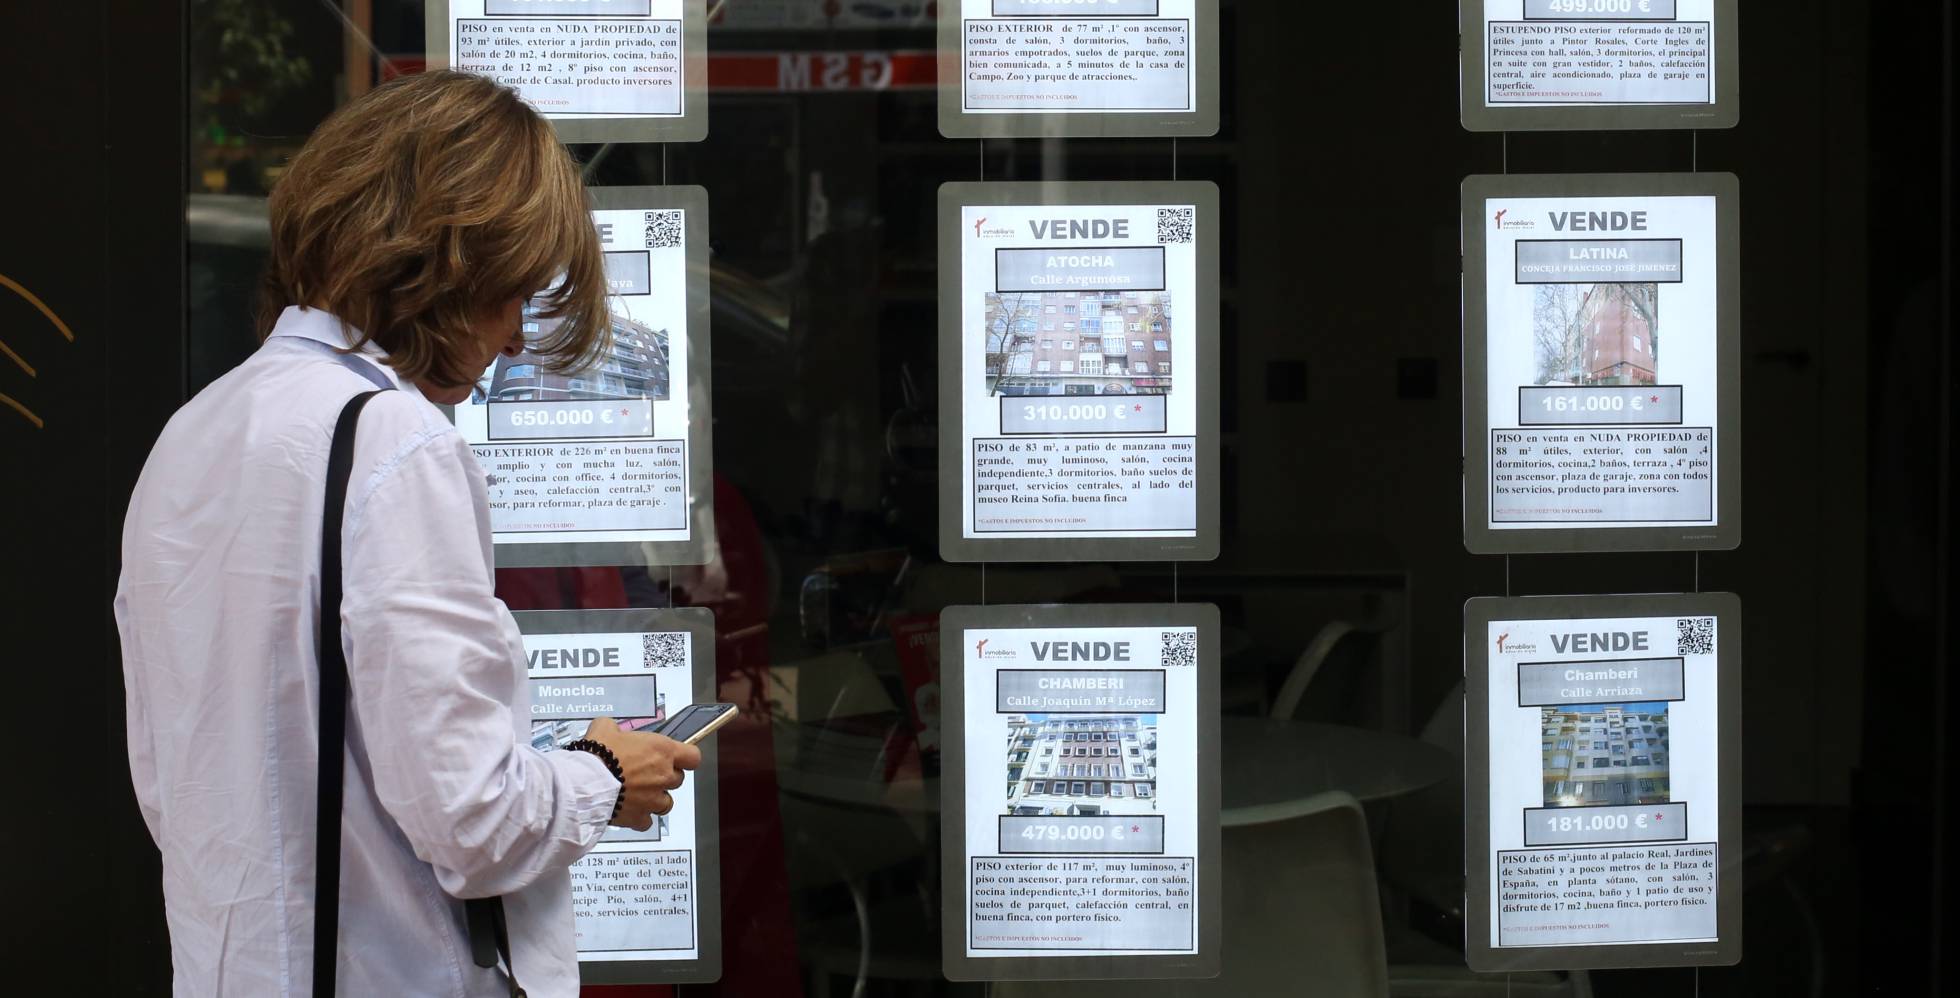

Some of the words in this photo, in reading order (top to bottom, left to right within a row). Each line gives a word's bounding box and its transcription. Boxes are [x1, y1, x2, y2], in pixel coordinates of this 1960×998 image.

[1550, 0, 1631, 13] 499.000
[461, 23, 487, 33] PISO
[508, 25, 535, 33] venta
[556, 23, 588, 33] NUDA
[594, 24, 660, 34] PROPIEDAD
[665, 24, 676, 34] de
[1493, 25, 1551, 34] ESTUPENDO
[1554, 25, 1576, 34] PISO
[1579, 25, 1611, 34] exterior
[1618, 26, 1661, 34] reformado
[1664, 26, 1674, 34] de
[1678, 26, 1691, 34] 120
[1492, 36, 1515, 44] útiles
[1521, 36, 1543, 47] junto
[1562, 36, 1588, 45] Pintor
[1634, 36, 1658, 45] Corte
[1695, 37, 1705, 45] de
[968, 47, 1009, 56] armarios
[1075, 47, 1102, 56] suelos
[1107, 47, 1118, 56] de
[968, 59, 988, 68] bien
[1066, 59, 1072, 68] 5
[1077, 59, 1114, 68] minutos
[1119, 59, 1130, 68] de
[1135, 59, 1144, 68] la
[1173, 59, 1185, 68] de
[1548, 210, 1648, 231] VENDE
[1029, 219, 1130, 240] VENDE
[1569, 247, 1629, 260] LATINA
[1046, 255, 1115, 268] ATOCHA
[1562, 264, 1612, 273] FRANCISCO
[1030, 274, 1063, 285] Calle
[1065, 273, 1131, 287] Argumosa
[1542, 396, 1624, 411] 161.000
[1630, 395, 1643, 411] €
[510, 409, 594, 426] 650.000
[600, 408, 614, 425] €
[1023, 404, 1107, 421] 310.000
[1113, 404, 1127, 420] €
[1496, 433, 1522, 443] PISO
[1542, 434, 1568, 442] venta
[1590, 432, 1621, 442] NUDA
[1627, 432, 1692, 442] PROPIEDAD
[1696, 431, 1708, 441] de
[494, 447, 553, 457] EXTERIOR
[559, 446, 571, 456] de
[574, 446, 591, 456] 226
[624, 445, 653, 455] buena
[656, 444, 680, 454] finca
[1026, 480, 1069, 490] servicios
[1131, 479, 1140, 489] al
[1149, 479, 1170, 489] lado
[1178, 479, 1193, 489] del
[1495, 484, 1509, 493] los
[1557, 483, 1601, 496] producto
[1602, 486, 1625, 496] para
[1011, 493, 1039, 503] Reina
[1071, 493, 1101, 503] buena
[1103, 493, 1127, 502] finca
[1550, 631, 1649, 654] VENDE
[1030, 641, 1131, 661] VENDE
[527, 647, 620, 670] VENDE
[1564, 667, 1638, 681] Chamberi
[1038, 677, 1124, 690] CHAMBERI
[538, 685, 605, 697] Moncloa
[1560, 687, 1592, 698] Calle
[1595, 686, 1643, 697] Arriaza
[531, 703, 562, 714] Calle
[566, 702, 614, 713] Arriaza
[1006, 696, 1039, 706] Calle
[1119, 696, 1155, 708] López
[1547, 814, 1628, 832] 181.000
[1635, 813, 1648, 829] €
[1021, 825, 1105, 840] 479.000
[1111, 824, 1125, 840] €
[587, 857, 603, 867] 128
[654, 855, 663, 865] al
[666, 854, 687, 864] lado
[1502, 866, 1513, 876] de
[1517, 865, 1555, 875] Sabatini
[1559, 867, 1564, 876] y
[1579, 865, 1605, 875] pocos
[1609, 863, 1640, 872] metros
[1644, 861, 1656, 870] de
[1660, 860, 1668, 870] la
[1673, 859, 1697, 869] Plaza
[1702, 859, 1712, 868] de
[607, 882, 639, 891] centro
[641, 879, 688, 890] comercial
[975, 899, 1003, 909] suelos
[1010, 899, 1021, 909] de
[1075, 899, 1128, 909] calefacción
[975, 912, 1004, 921] buena
[1055, 913, 1091, 924] portero
